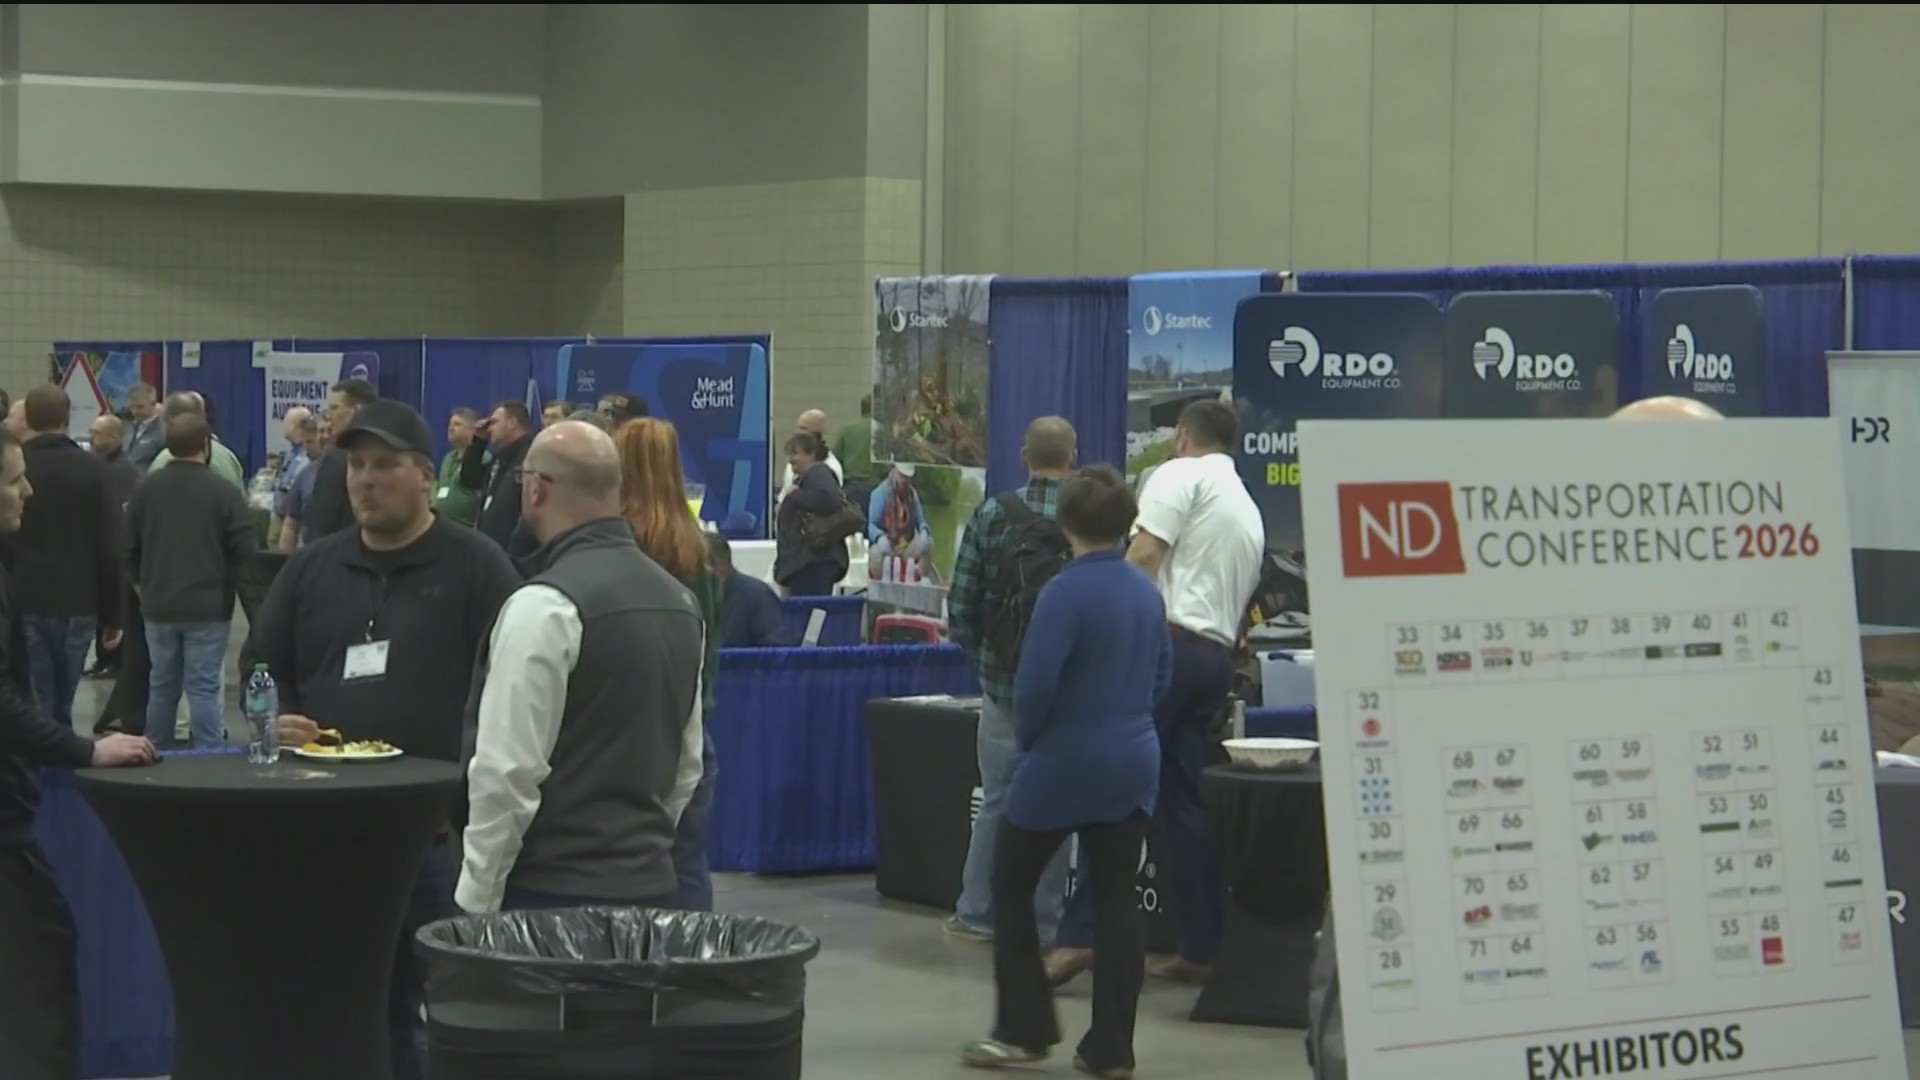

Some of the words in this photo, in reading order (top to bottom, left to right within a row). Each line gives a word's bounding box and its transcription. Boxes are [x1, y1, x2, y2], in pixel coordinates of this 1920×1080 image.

[909, 312, 949, 328] Stantec
[1165, 312, 1212, 329] Stantec
[1323, 352, 1394, 377] RDO
[1517, 353, 1575, 379] RDO
[1694, 353, 1732, 380] RDO
[271, 379, 328, 400] EQUIPMENT
[697, 376, 733, 393] Mead
[1322, 379, 1384, 389] EQUIPMENT
[1516, 381, 1565, 391] EQUIPMENT
[691, 391, 734, 410] &Hunt
[1852, 417, 1890, 443] HDR
[1459, 481, 1784, 521] TRANSPORTATION
[1359, 501, 1442, 560] ND
[1477, 525, 1729, 569] CONFERENCE
[1735, 522, 1820, 560] 2026
[1572, 619, 1588, 636] 37
[1612, 617, 1630, 634] 38
[1653, 616, 1671, 632] 39
[1692, 614, 1711, 630] 40
[1733, 613, 1747, 627] 41
[1771, 611, 1788, 627] 42
[1398, 626, 1418, 644] 33
[1440, 625, 1461, 641] 34
[1485, 623, 1504, 640] 35
[1529, 621, 1548, 638] 36
[1814, 669, 1831, 684] 43
[1360, 693, 1379, 710] 32
[1704, 736, 1721, 752] 52
[1744, 734, 1757, 750] 51
[1821, 729, 1838, 743] 44
[1496, 748, 1515, 766] 67
[1580, 744, 1600, 760] 60
[1623, 741, 1640, 758] 59
[1366, 757, 1381, 775] 31
[1453, 751, 1473, 768] 68
[1749, 794, 1767, 811] 50
[1826, 788, 1844, 804] 45
[1628, 803, 1646, 820] 58
[1709, 796, 1728, 814] 53
[1502, 811, 1523, 829] 66
[1586, 806, 1602, 823] 61
[1370, 821, 1391, 839] 30
[1459, 815, 1479, 832] 69
[1755, 853, 1772, 871] 49
[1832, 848, 1850, 866] 46
[1633, 863, 1650, 881] 57
[1716, 858, 1733, 874] 54
[1507, 873, 1527, 891] 65
[1591, 867, 1610, 884] 62
[1375, 885, 1395, 902] 29
[1464, 877, 1484, 894] 70
[1761, 915, 1779, 931] 48
[1839, 907, 1855, 922] 47
[1638, 925, 1656, 942] 56
[1721, 919, 1739, 936] 55
[1512, 937, 1531, 953] 64
[1596, 928, 1616, 945] 63
[1469, 939, 1486, 956] 71
[1381, 951, 1401, 969] 28
[1526, 1024, 1744, 1080] EXHIBITORS
